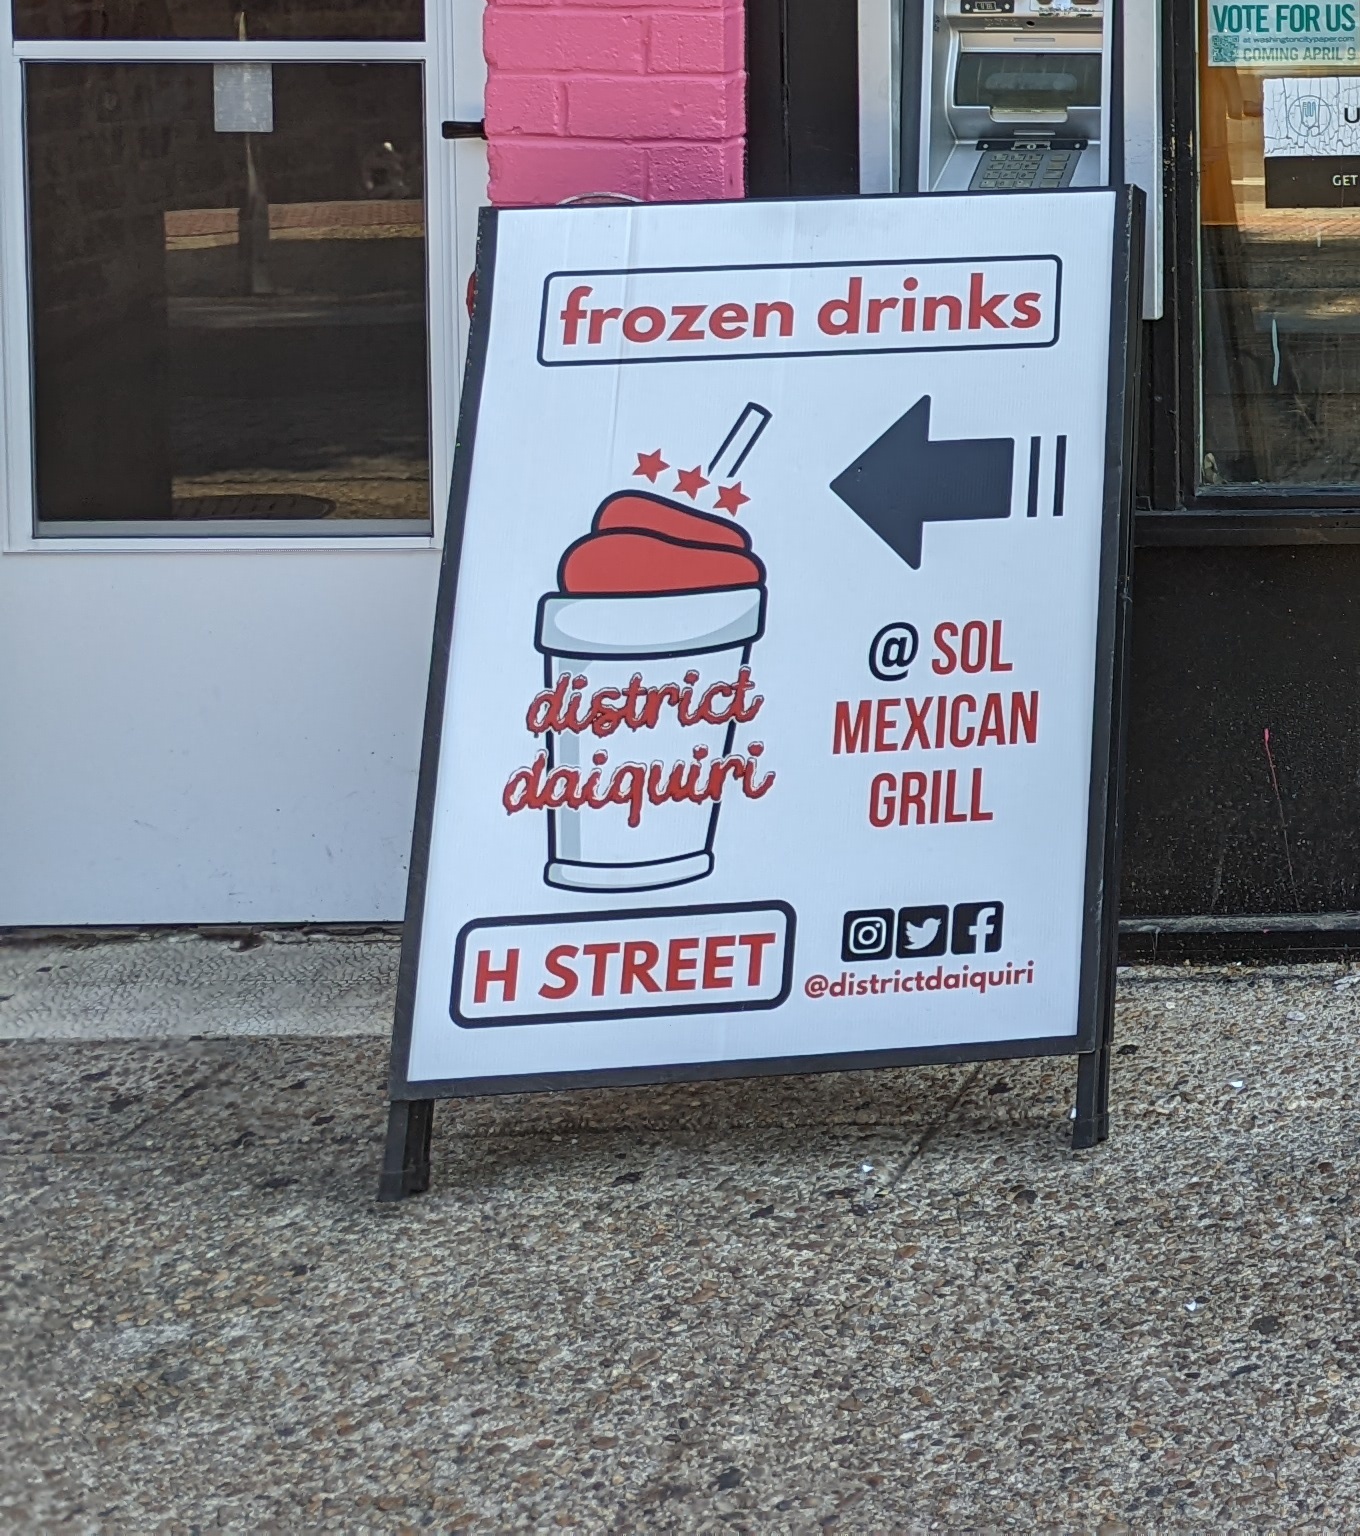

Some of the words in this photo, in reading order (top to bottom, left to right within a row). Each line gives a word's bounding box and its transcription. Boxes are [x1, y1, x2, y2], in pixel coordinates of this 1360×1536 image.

[1212, 4, 1269, 33] VOTE
[1276, 4, 1320, 32] FOR
[1326, 4, 1356, 33] US
[1253, 36, 1355, 44] washingtoncitypaper.com
[1243, 47, 1299, 62] COMING
[1303, 47, 1343, 61] APRIL
[1347, 47, 1356, 61] 9
[1332, 175, 1358, 186] GET
[559, 284, 795, 349] frozen
[816, 272, 1044, 337] drinks
[868, 621, 919, 682] @
[932, 620, 1013, 675] SOL
[526, 664, 764, 737] district
[832, 691, 1039, 755] MEXICAN
[501, 741, 776, 828] daiquiri
[868, 767, 994, 826] GRILL
[473, 949, 519, 1005] H
[540, 931, 777, 998] STREET
[803, 959, 1035, 998] @districtdaiquiri
